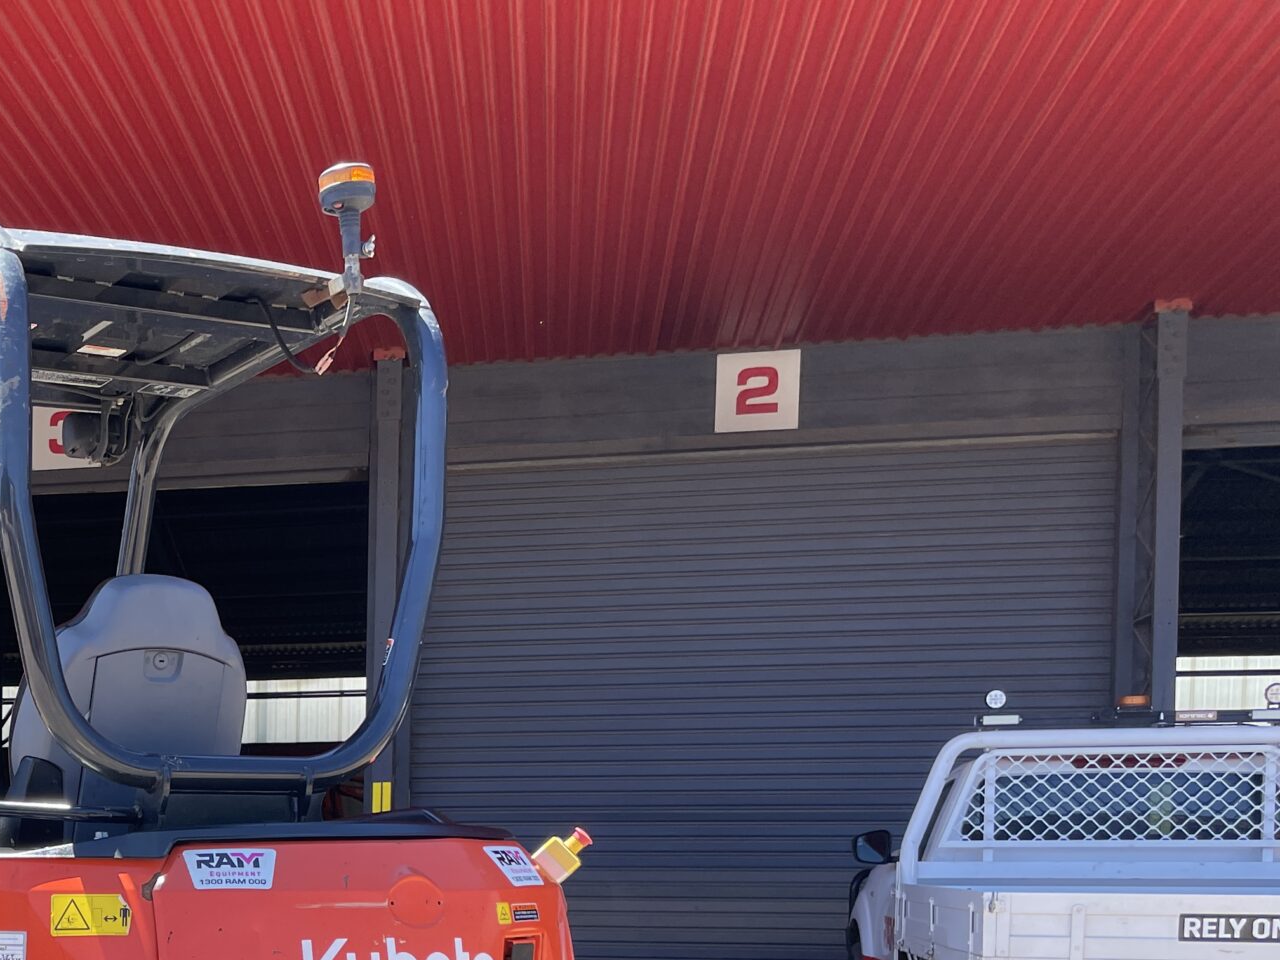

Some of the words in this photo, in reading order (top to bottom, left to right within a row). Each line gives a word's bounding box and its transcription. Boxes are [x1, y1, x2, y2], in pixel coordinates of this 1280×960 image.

[736, 366, 779, 415] 2
[195, 853, 264, 869] RAM
[491, 850, 528, 867] RAM
[1183, 917, 1247, 939] RELY
